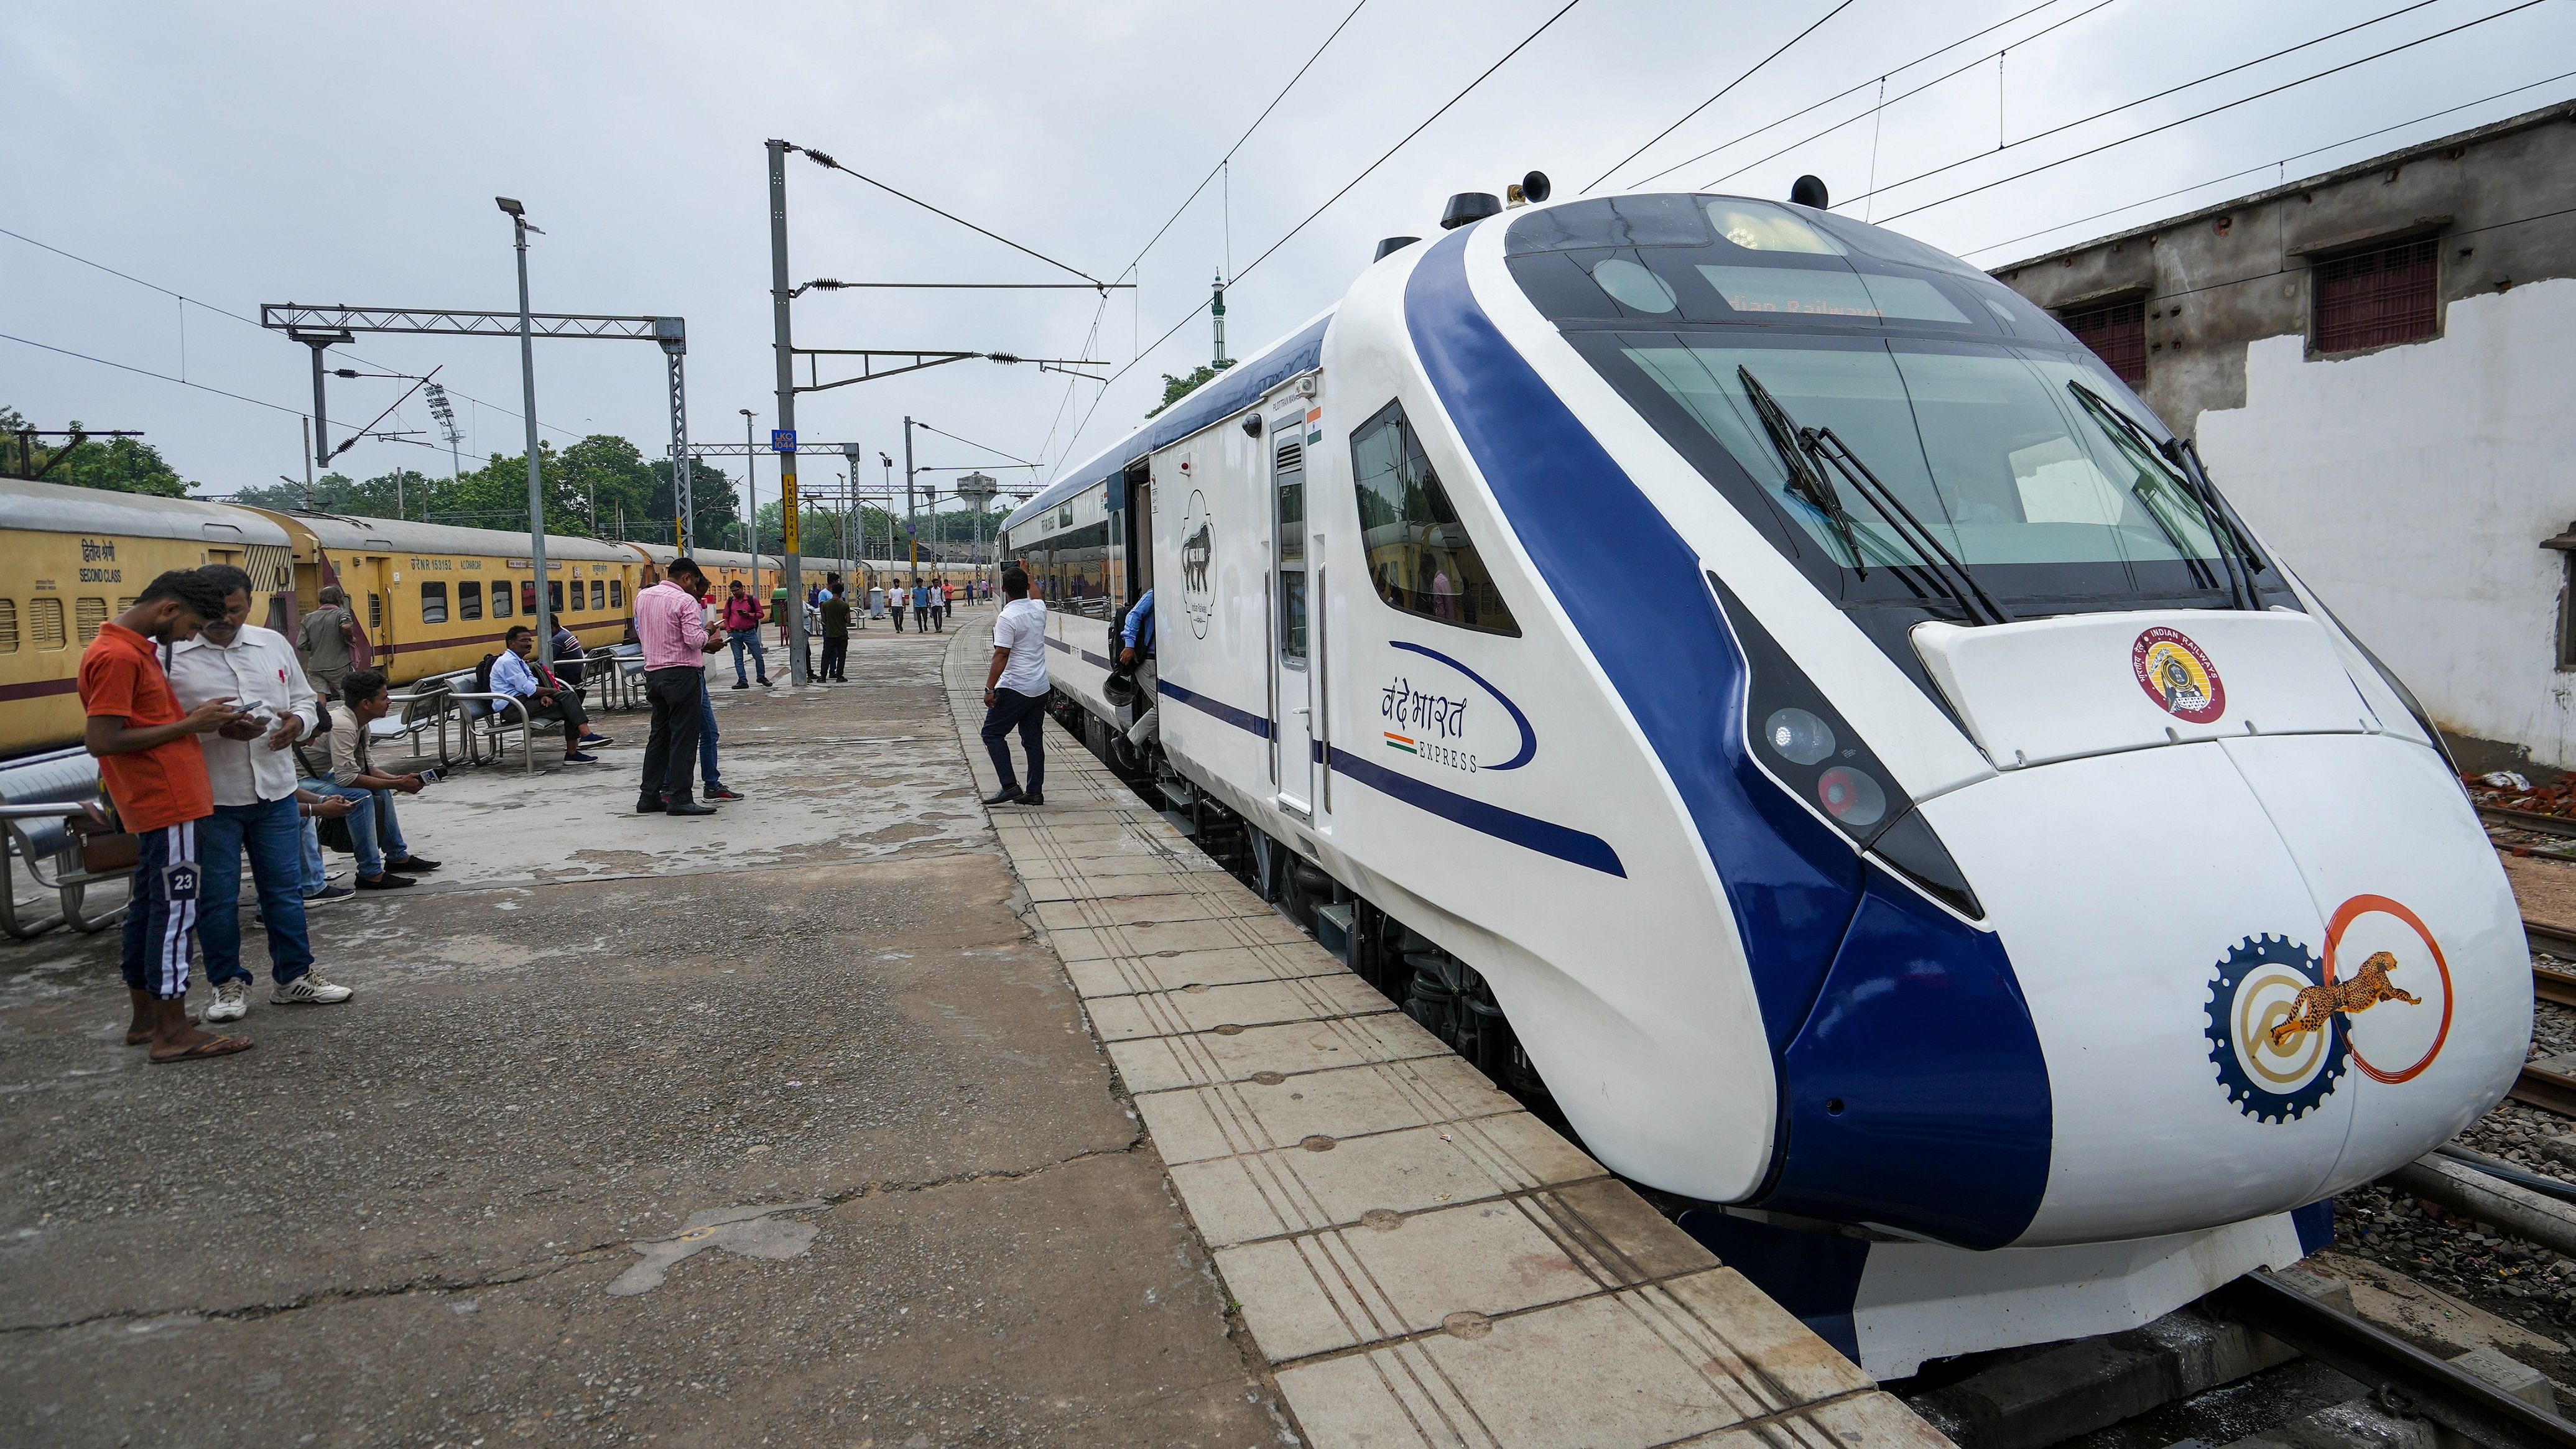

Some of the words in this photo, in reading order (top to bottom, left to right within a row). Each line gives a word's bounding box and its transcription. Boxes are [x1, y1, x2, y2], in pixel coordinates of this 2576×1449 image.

[774, 441, 795, 450] 1044
[775, 432, 794, 441] LKO
[81, 538, 101, 563] द्वितीय
[79, 568, 103, 583] SECOND
[103, 569, 121, 583] CLASS
[2150, 628, 2178, 639] INDIAN
[2182, 636, 2218, 679] RAILWAYS
[1382, 676, 1410, 732] वंदे
[1412, 690, 1467, 739] भारत
[1419, 741, 1477, 774] EXPRESS
[174, 874, 193, 891] 23
